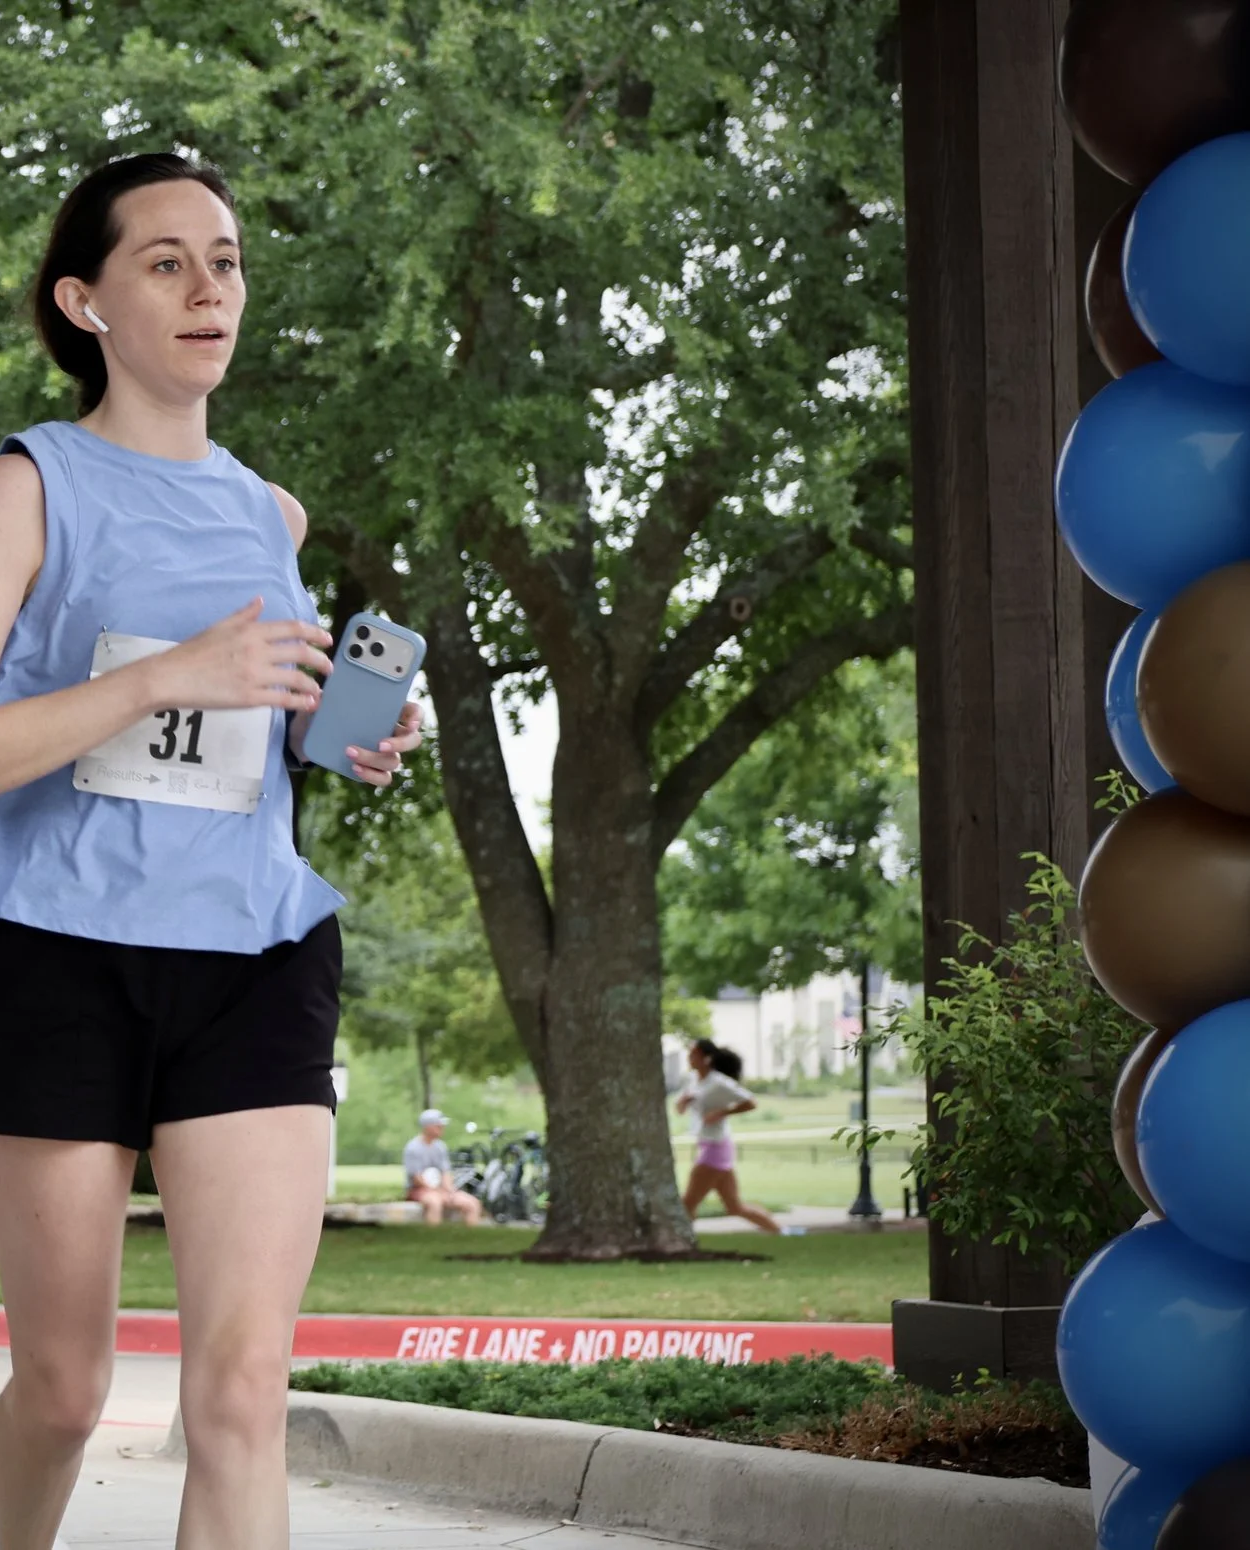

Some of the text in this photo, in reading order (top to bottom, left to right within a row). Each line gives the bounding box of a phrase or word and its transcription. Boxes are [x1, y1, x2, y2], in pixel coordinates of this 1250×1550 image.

[148, 708, 204, 765] 31
[96, 764, 143, 783] Results
[396, 1326, 755, 1366] FIRE LANE NO PARKING
